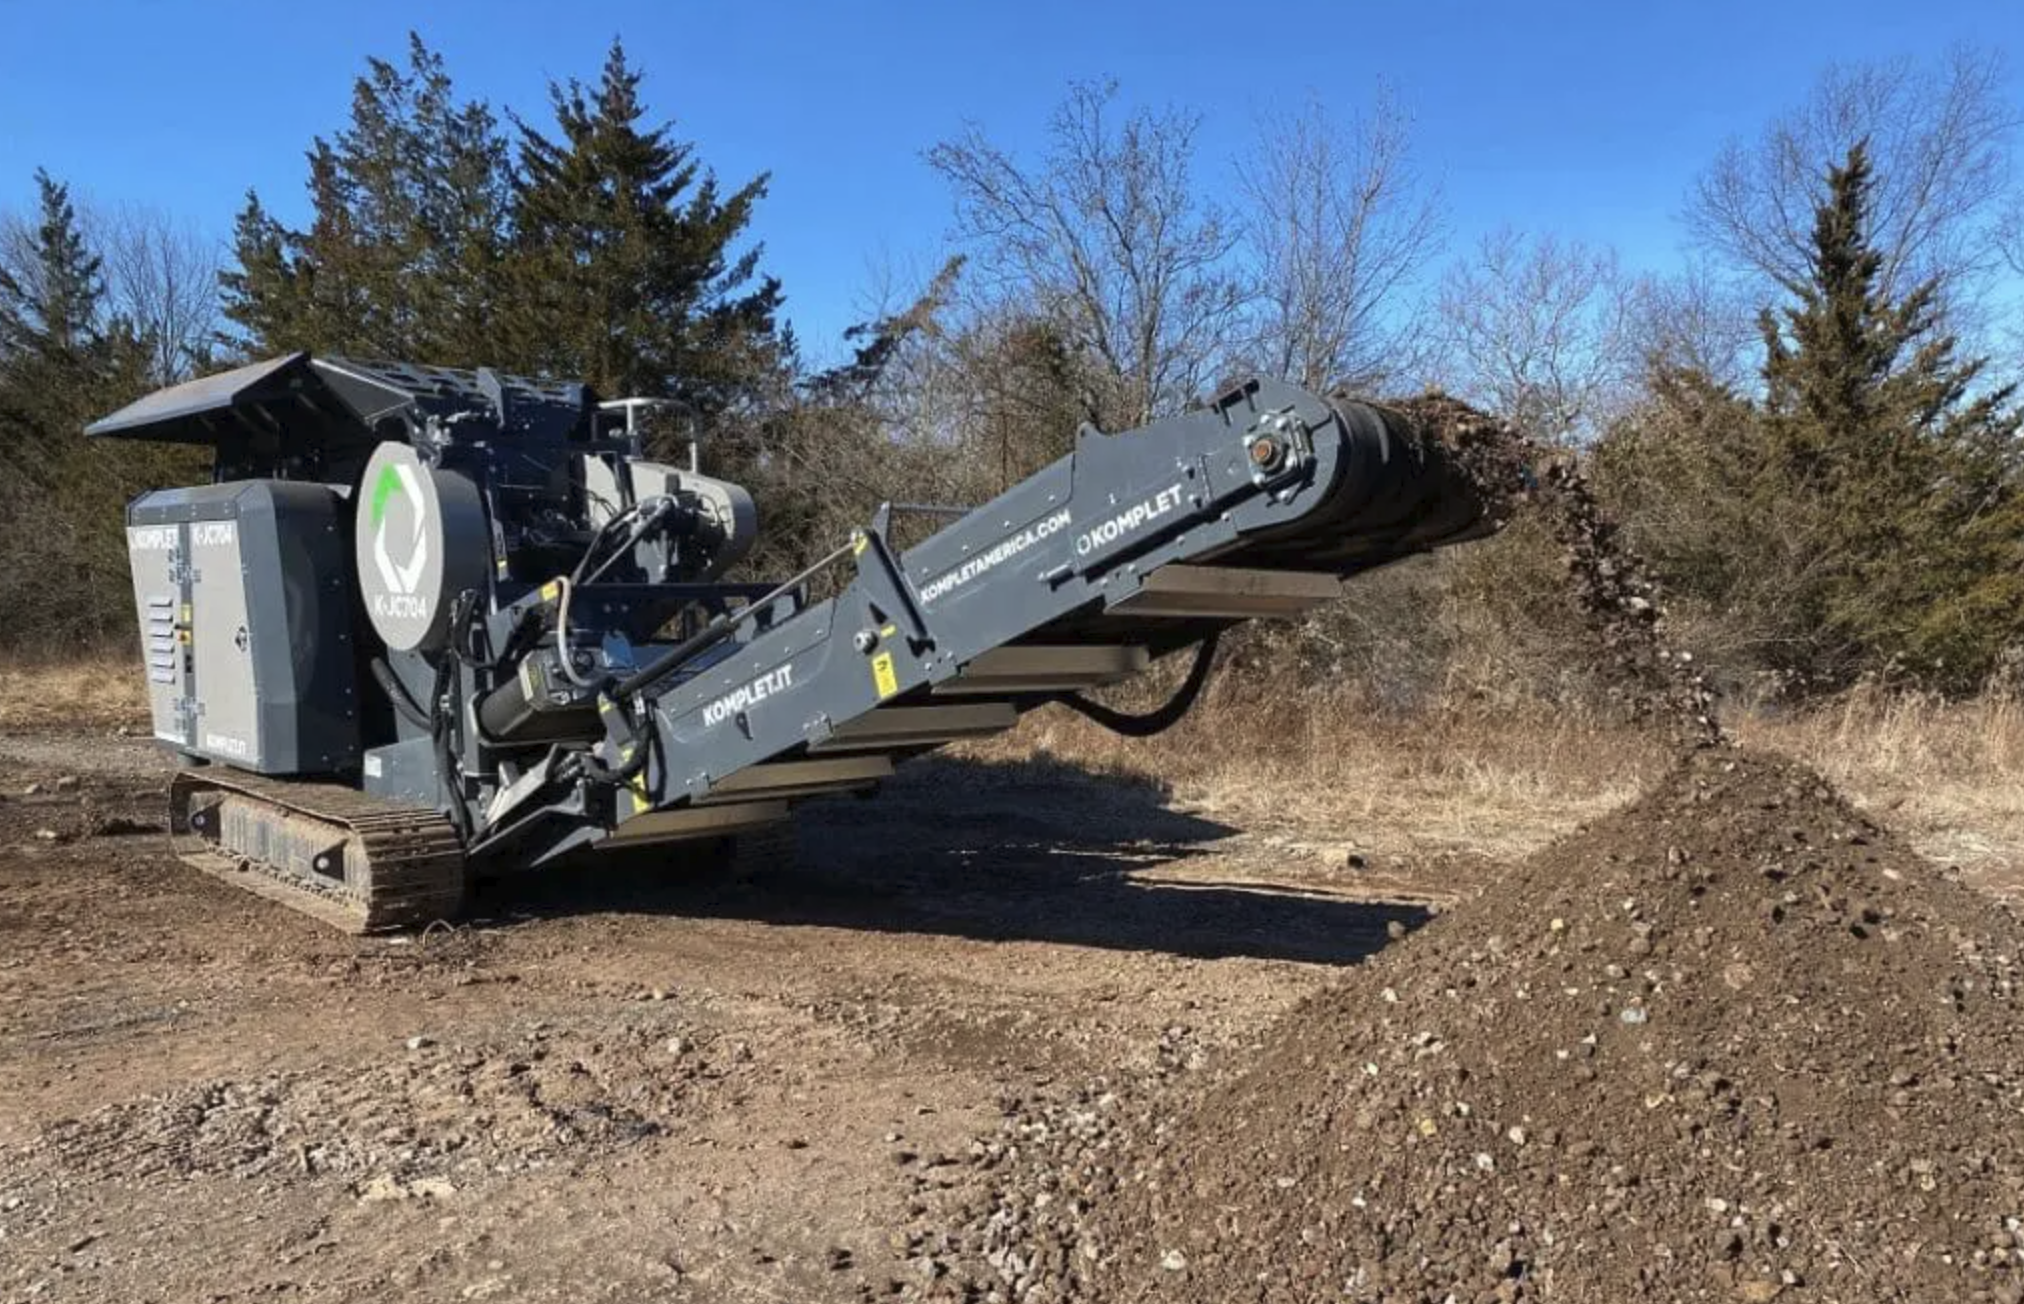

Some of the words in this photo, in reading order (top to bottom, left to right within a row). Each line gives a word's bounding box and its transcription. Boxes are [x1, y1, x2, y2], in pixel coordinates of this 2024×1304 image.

[1090, 483, 1182, 549] KOMPLET
[920, 508, 1072, 605] KOMPLETAMERICA.COM
[702, 664, 793, 727] KOMPLET.IT
